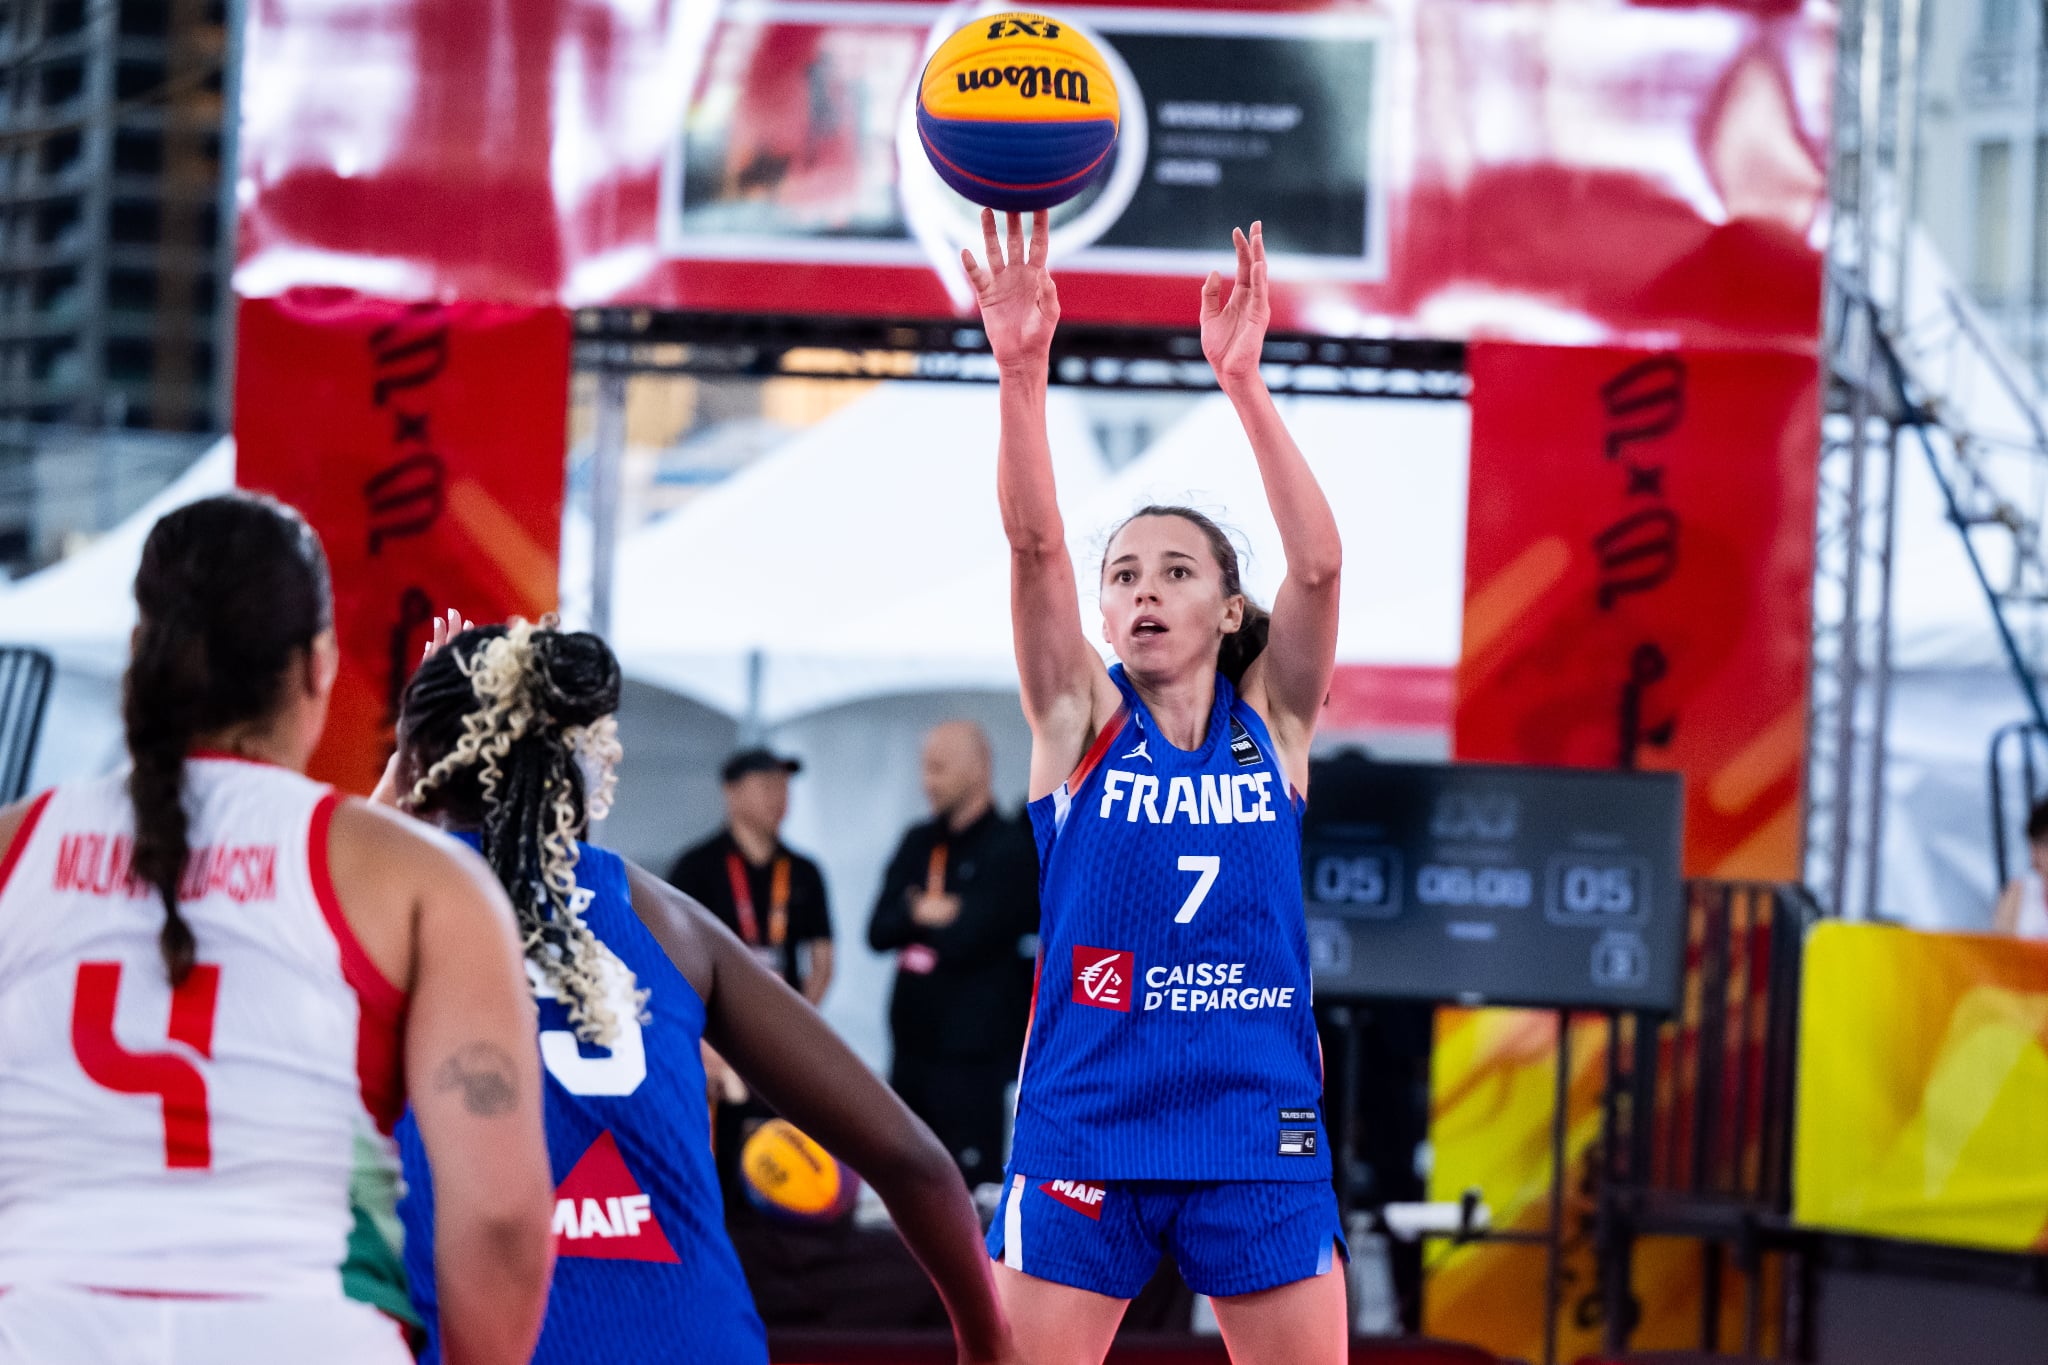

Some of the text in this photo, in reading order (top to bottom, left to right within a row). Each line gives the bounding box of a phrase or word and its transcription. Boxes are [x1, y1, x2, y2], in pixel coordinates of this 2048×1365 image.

[957, 66, 1091, 104] Wilson
[1100, 769, 1276, 824] FRANCE
[1174, 856, 1220, 923] 7
[1314, 856, 1385, 903] 05
[1564, 865, 1634, 914] 05
[1144, 987, 1295, 1012] D'EPARGNE
[1145, 963, 1246, 989] CAISSE
[71, 960, 221, 1170] 4
[1305, 1137, 1314, 1148] 42
[1051, 1179, 1106, 1206] MAIF
[551, 1193, 651, 1240] MAIF
